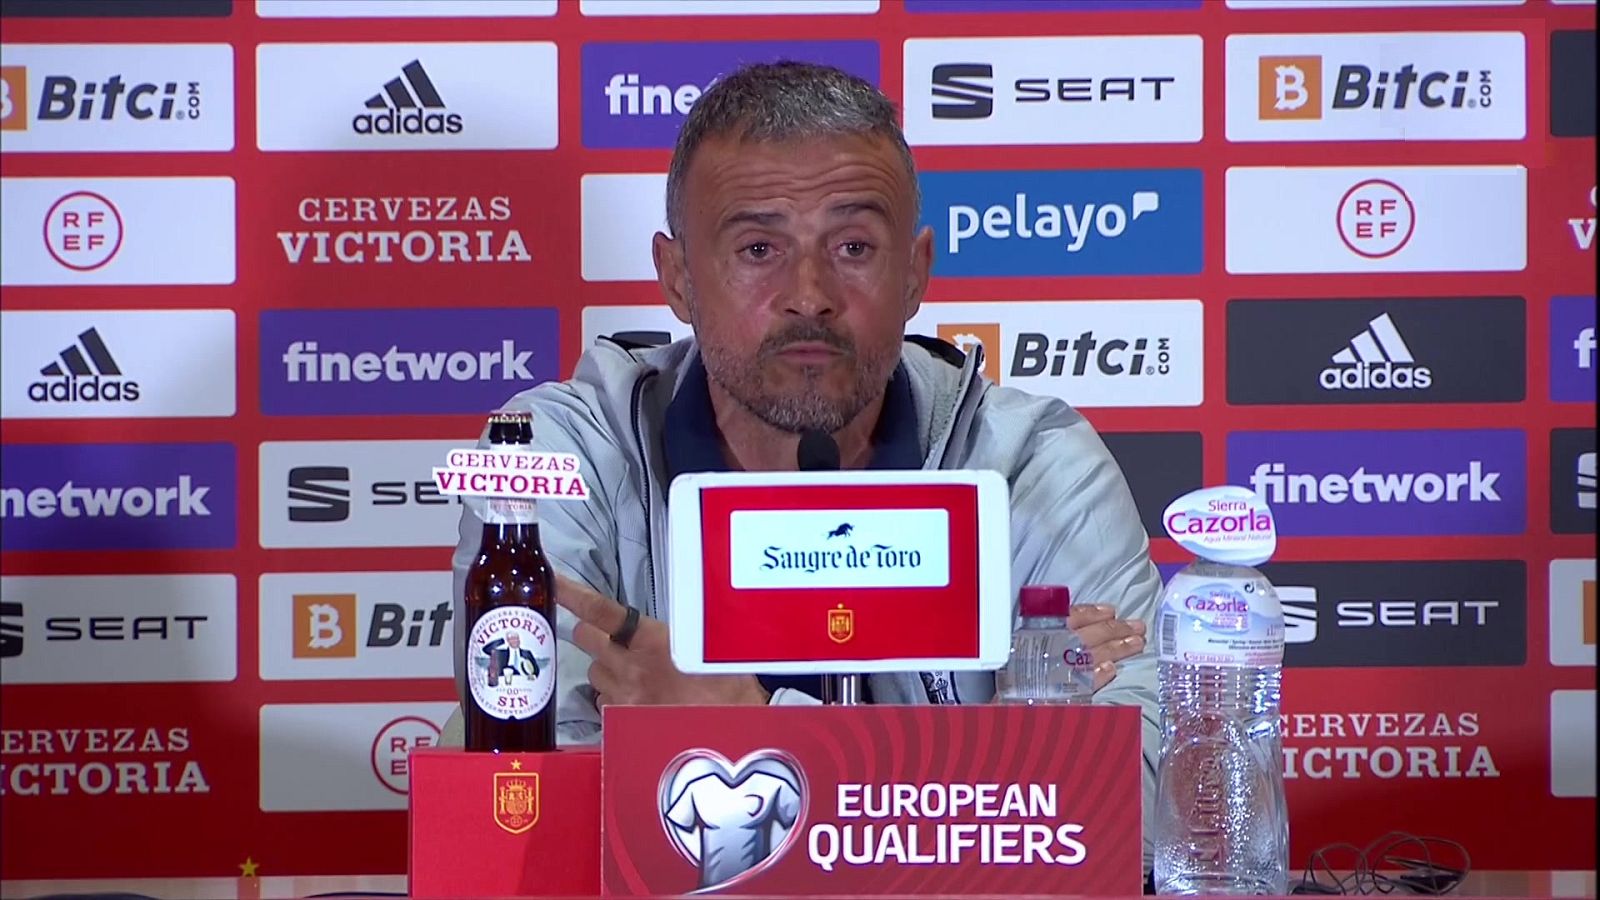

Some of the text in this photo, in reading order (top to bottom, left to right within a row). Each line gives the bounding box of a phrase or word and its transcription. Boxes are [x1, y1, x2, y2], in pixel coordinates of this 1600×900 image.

[38, 74, 177, 120] Bitci
[604, 73, 717, 115] fine
[1014, 76, 1175, 102] SEAT
[1332, 64, 1469, 109] Bitci
[352, 108, 463, 135] adidas
[298, 196, 511, 222] CERVEZAS
[949, 193, 1127, 253] pelayo
[277, 230, 531, 264] VICTORIA
[283, 341, 535, 382] finetwork
[1010, 331, 1147, 377] Bitci
[28, 376, 140, 402] adidas
[1319, 362, 1432, 390] adidas
[450, 452, 575, 471] CERVEZAS
[371, 481, 463, 505] SE
[436, 472, 586, 496] VICTORIA
[1251, 461, 1502, 502] finetwork
[0, 475, 211, 518] network
[1208, 500, 1247, 512] Sierra
[1168, 507, 1271, 535] Cazorla
[760, 544, 921, 573] Sangre de Toro
[1185, 595, 1249, 612] Cazorla
[1336, 601, 1499, 626] SEAT
[45, 615, 208, 641] SEAT
[366, 601, 454, 647] Bit
[477, 617, 547, 645] VICTORIA
[498, 695, 529, 708] SIN
[837, 783, 1057, 818] EUROPEAN
[807, 823, 1087, 871] QUALIFIERS
